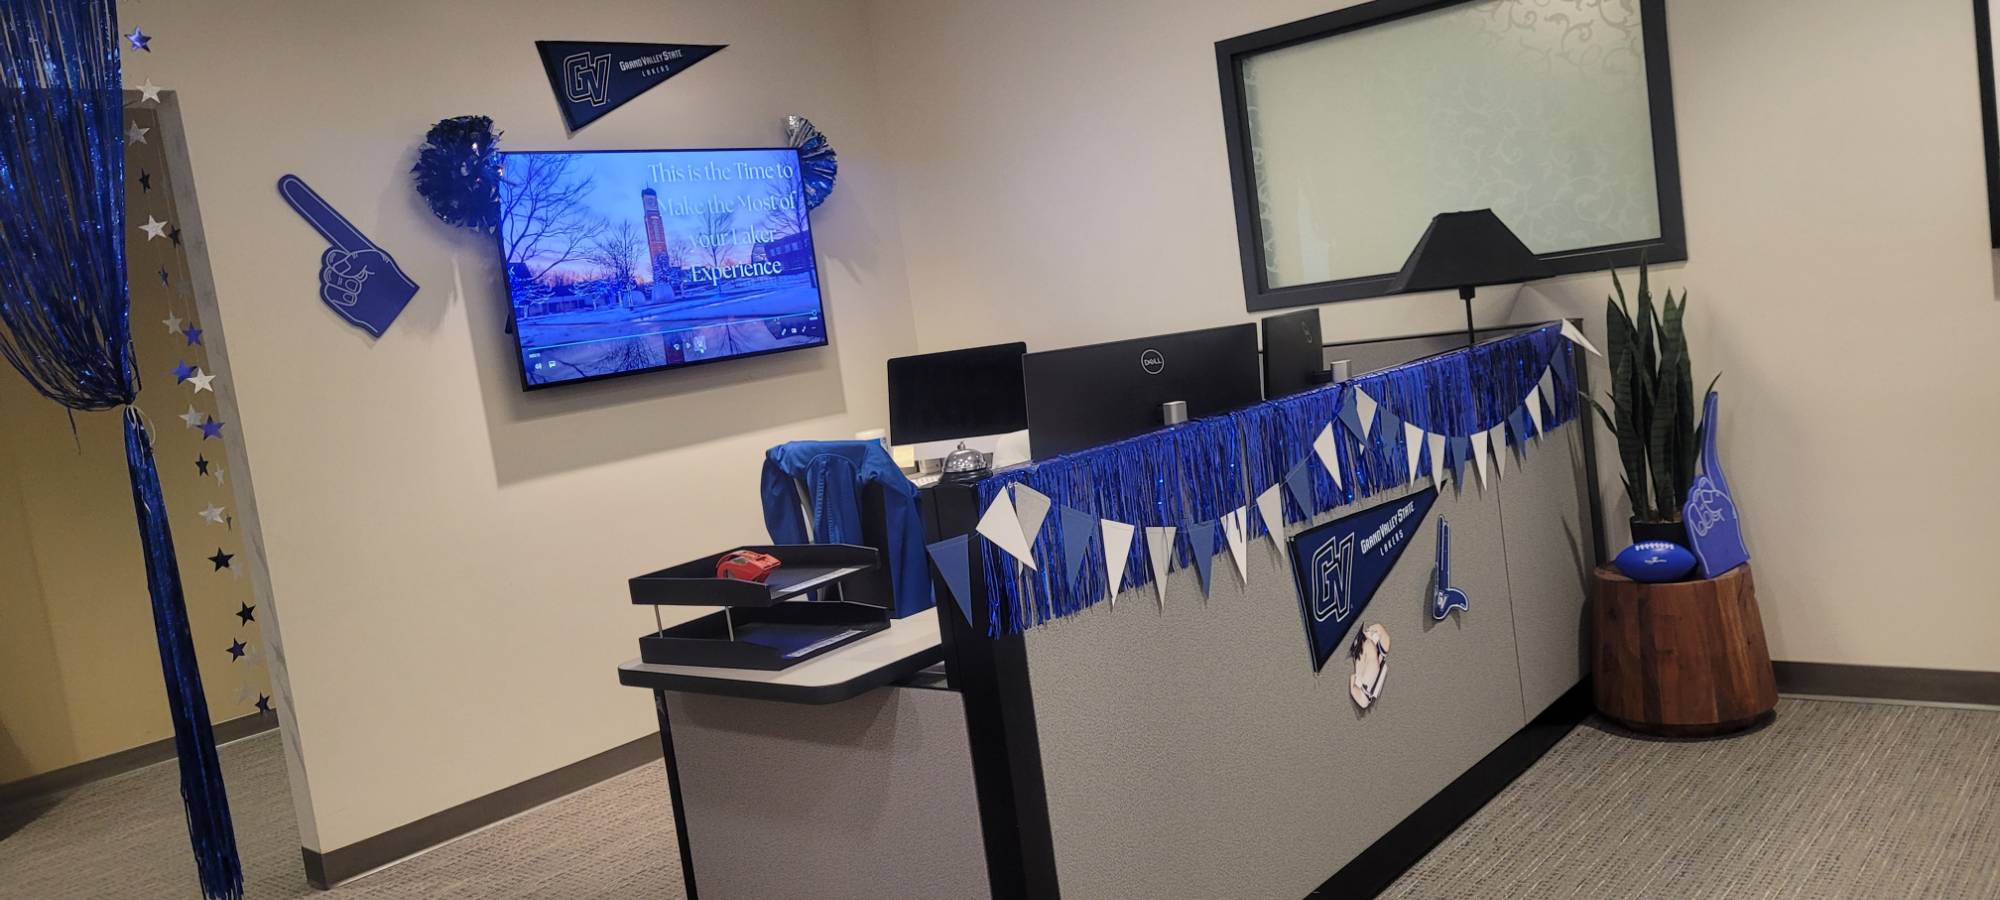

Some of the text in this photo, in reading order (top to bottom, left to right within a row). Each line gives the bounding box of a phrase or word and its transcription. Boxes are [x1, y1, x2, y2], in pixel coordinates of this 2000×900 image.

[562, 51, 612, 107] GV
[648, 161, 794, 184] This is the Time to
[658, 190, 797, 217] Make the Most of
[731, 224, 777, 246] Laker
[690, 260, 783, 287] Experience
[1380, 529, 1404, 557] LAKERS
[1312, 532, 1355, 622] GV
